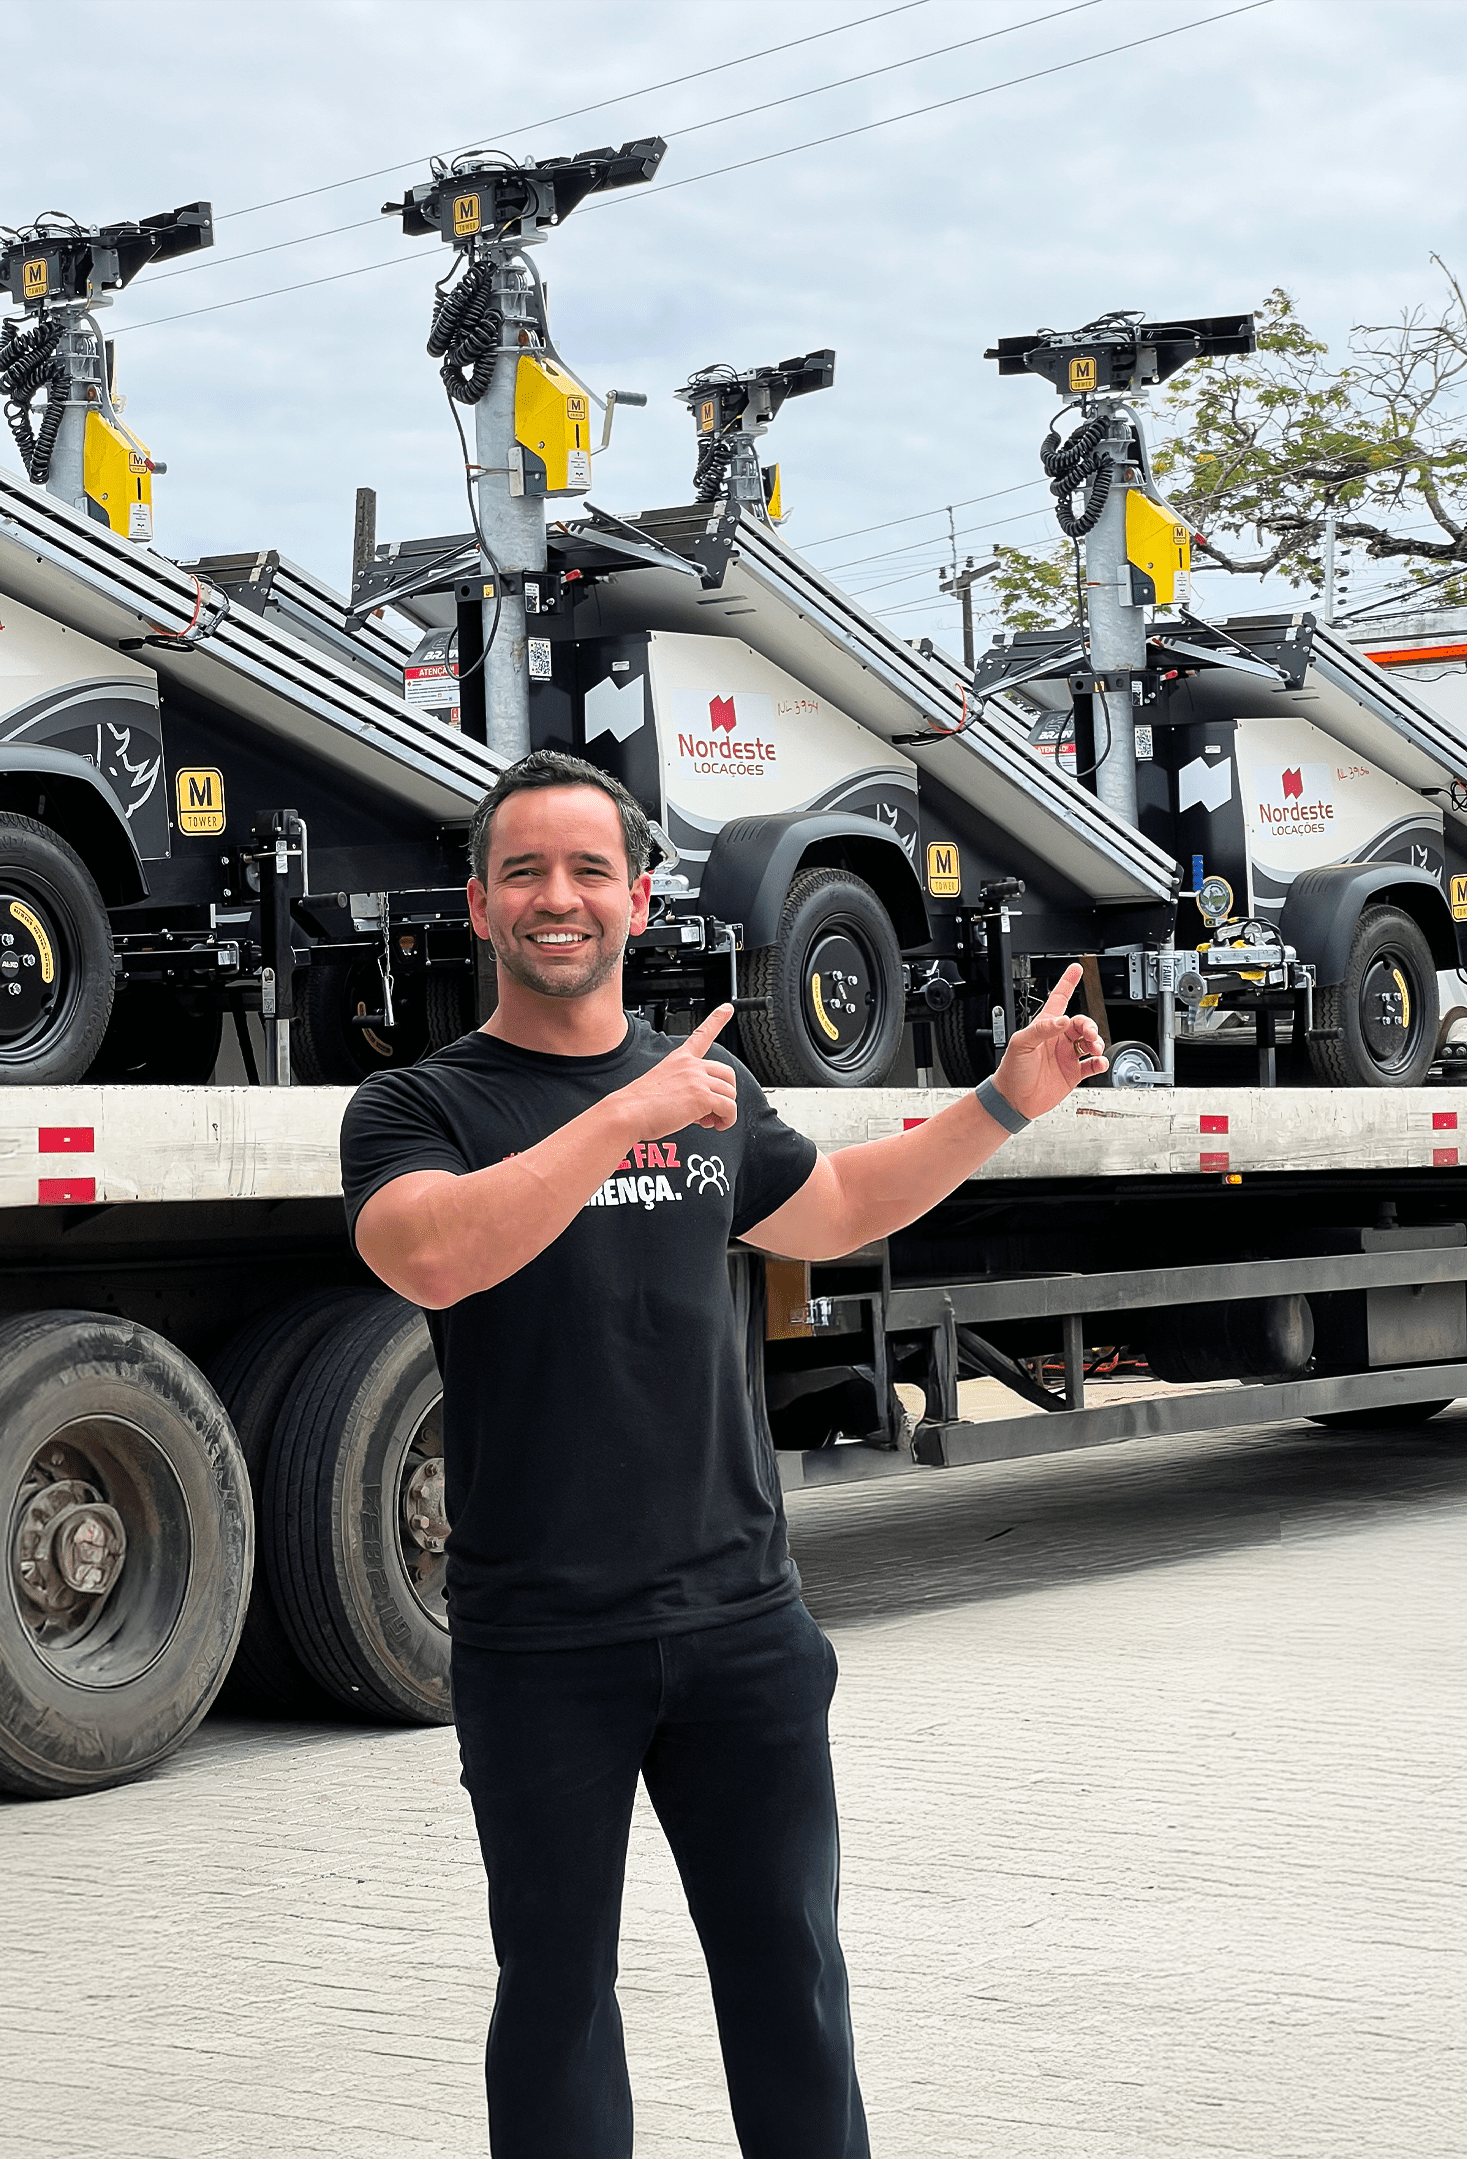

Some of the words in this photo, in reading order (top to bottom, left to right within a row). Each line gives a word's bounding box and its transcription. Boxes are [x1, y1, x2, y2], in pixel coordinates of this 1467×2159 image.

[460, 199, 473, 219] M
[30, 264, 42, 283] M
[1076, 362, 1090, 378] M
[571, 399, 581, 411] M
[678, 733, 776, 761] Nordeste
[694, 761, 764, 778] LOCAÇÕES
[189, 776, 212, 807] M
[187, 816, 218, 828] TOWER
[1259, 800, 1334, 824] Nordeste
[1271, 822, 1325, 836] LOCAÇÕES
[936, 849, 952, 874] M
[633, 1142, 681, 1169] FAZ
[585, 1174, 683, 1211] RENÇA.
